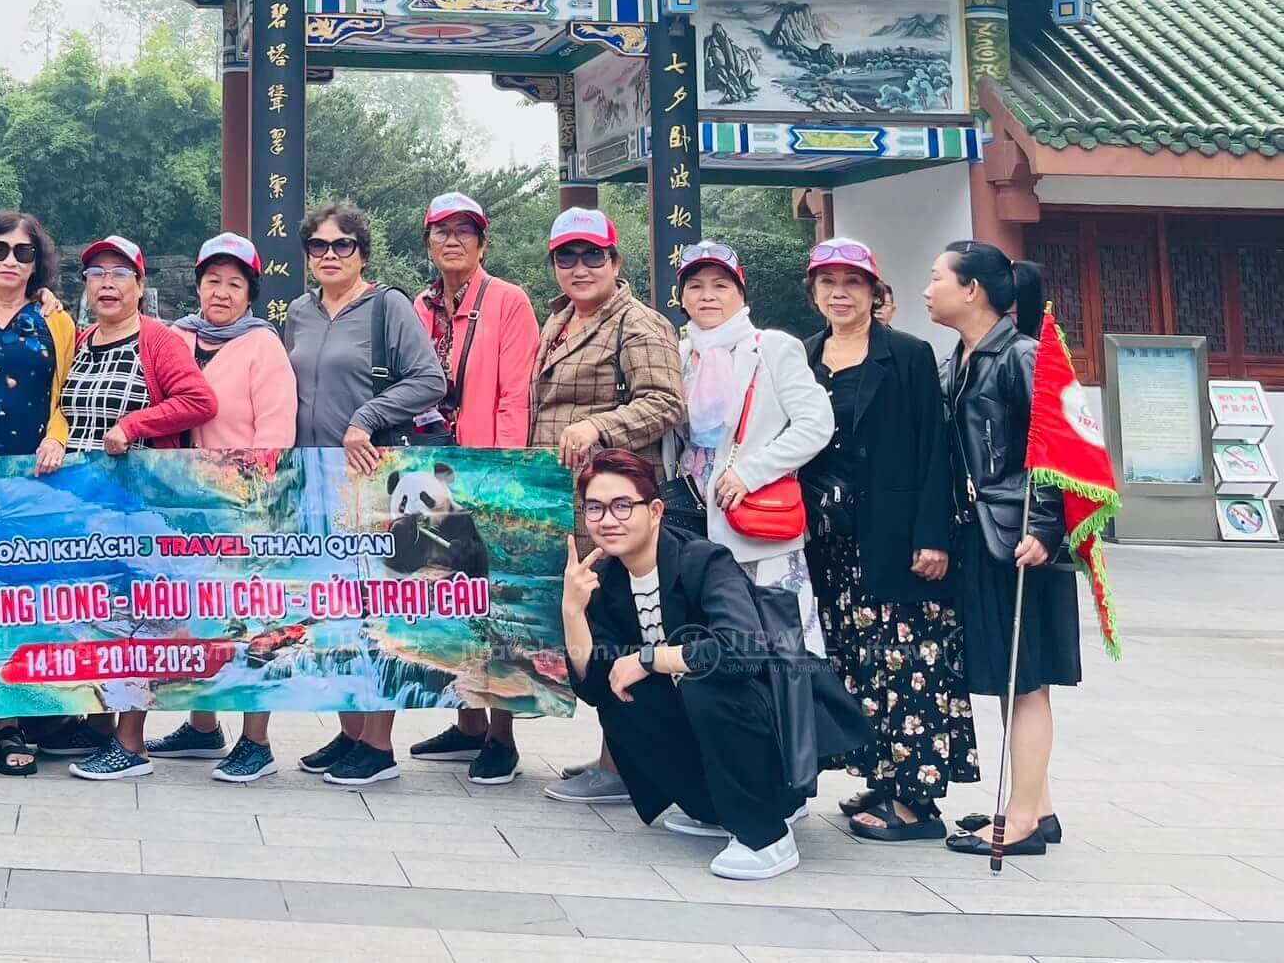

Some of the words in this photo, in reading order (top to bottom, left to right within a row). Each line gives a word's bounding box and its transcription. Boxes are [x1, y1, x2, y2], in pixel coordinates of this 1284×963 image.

[52, 533, 134, 562] KHÁCH
[139, 536, 153, 556] J
[158, 536, 250, 557] TRAVEL
[252, 535, 321, 557] THAM
[327, 534, 395, 559] QUAN
[43, 584, 110, 623] LONG
[131, 574, 190, 619] MÂU
[196, 580, 224, 618] NI
[231, 574, 285, 618] CÂU
[310, 574, 364, 618] CỬU
[365, 578, 429, 624] TRẠI
[434, 572, 490, 618] CÂU
[25, 648, 77, 677] 14.10
[97, 644, 206, 674] 20.10.2023
